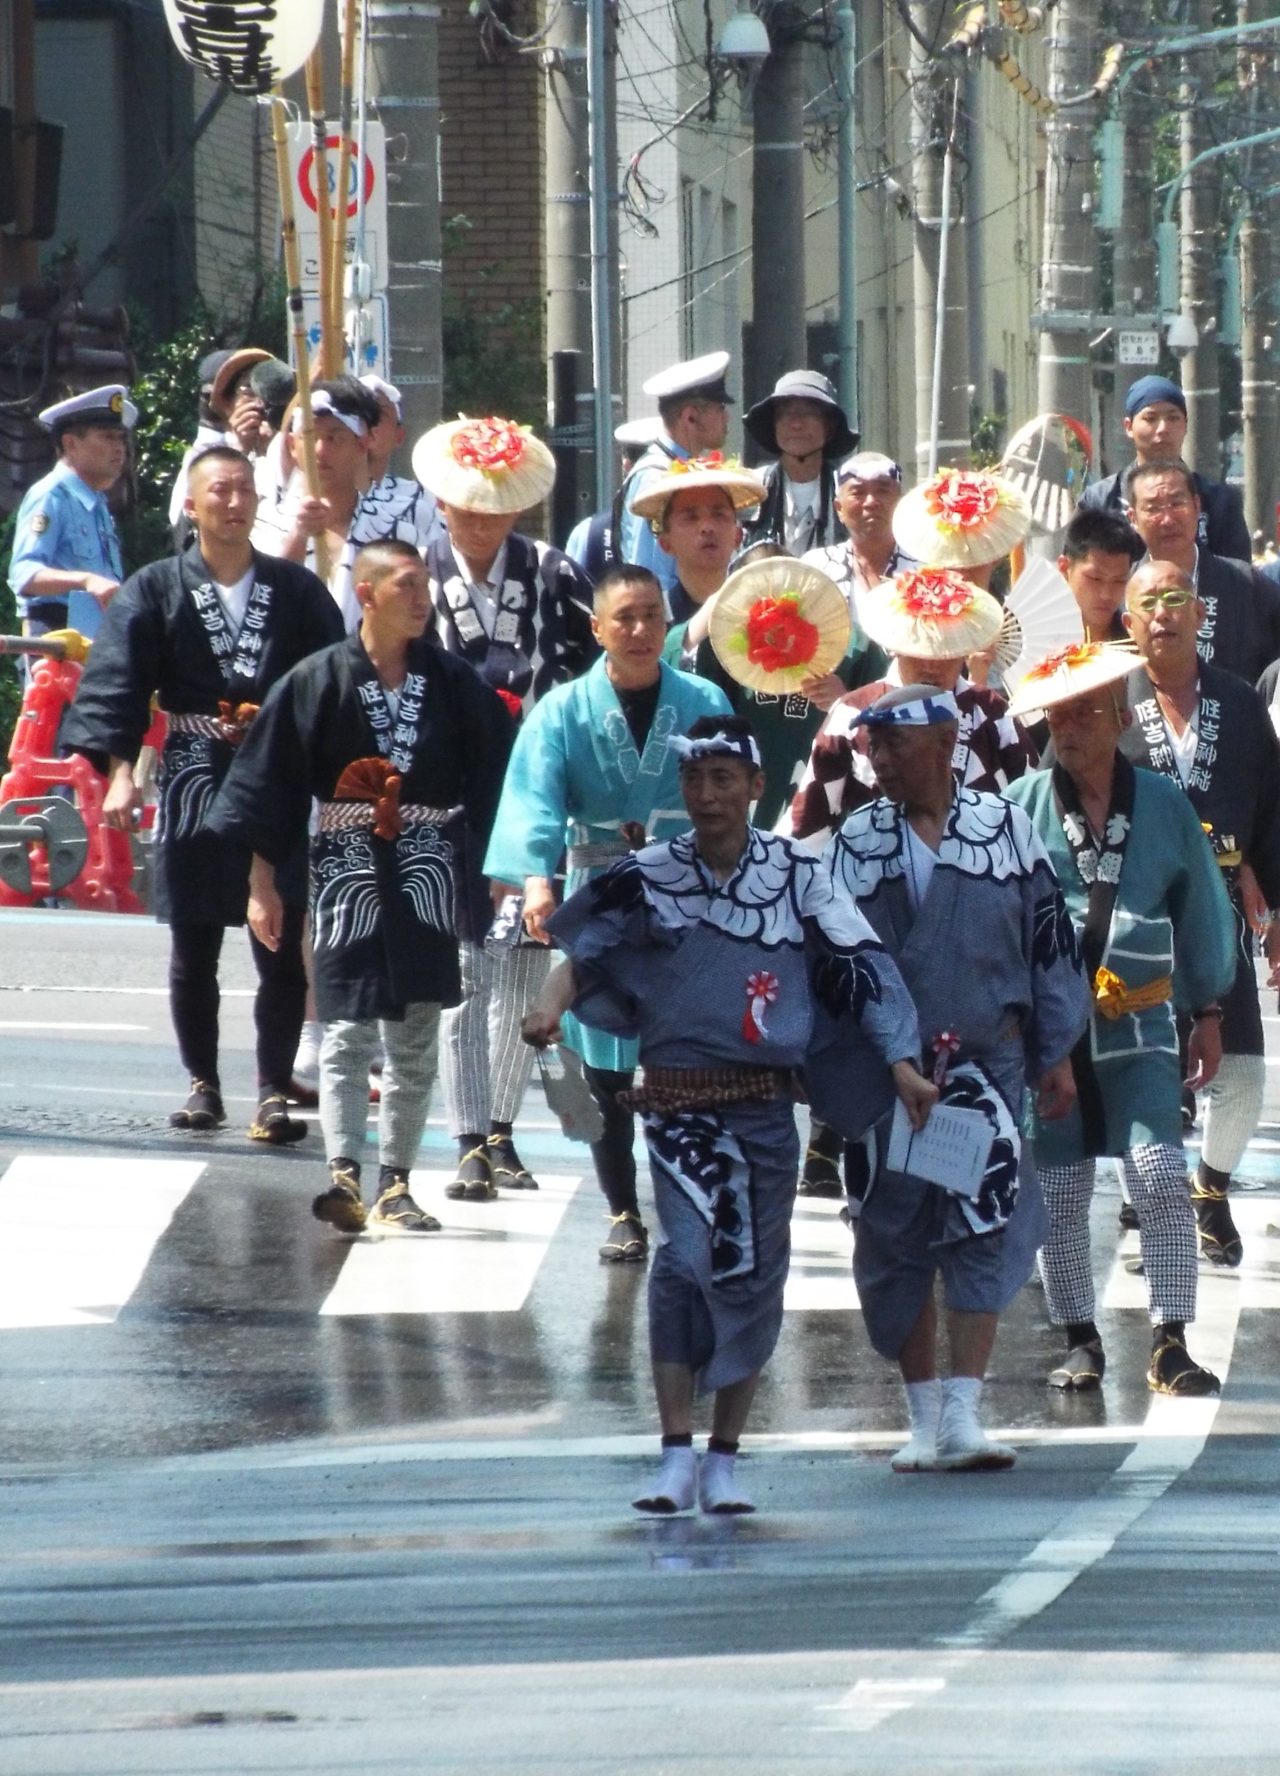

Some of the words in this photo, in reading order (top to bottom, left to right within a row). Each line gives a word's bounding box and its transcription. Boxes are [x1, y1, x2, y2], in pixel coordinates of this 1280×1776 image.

[233, 582, 273, 678] 住吉神社
[389, 672, 427, 774] 住吉神社
[1187, 697, 1221, 792] 住吉神社
